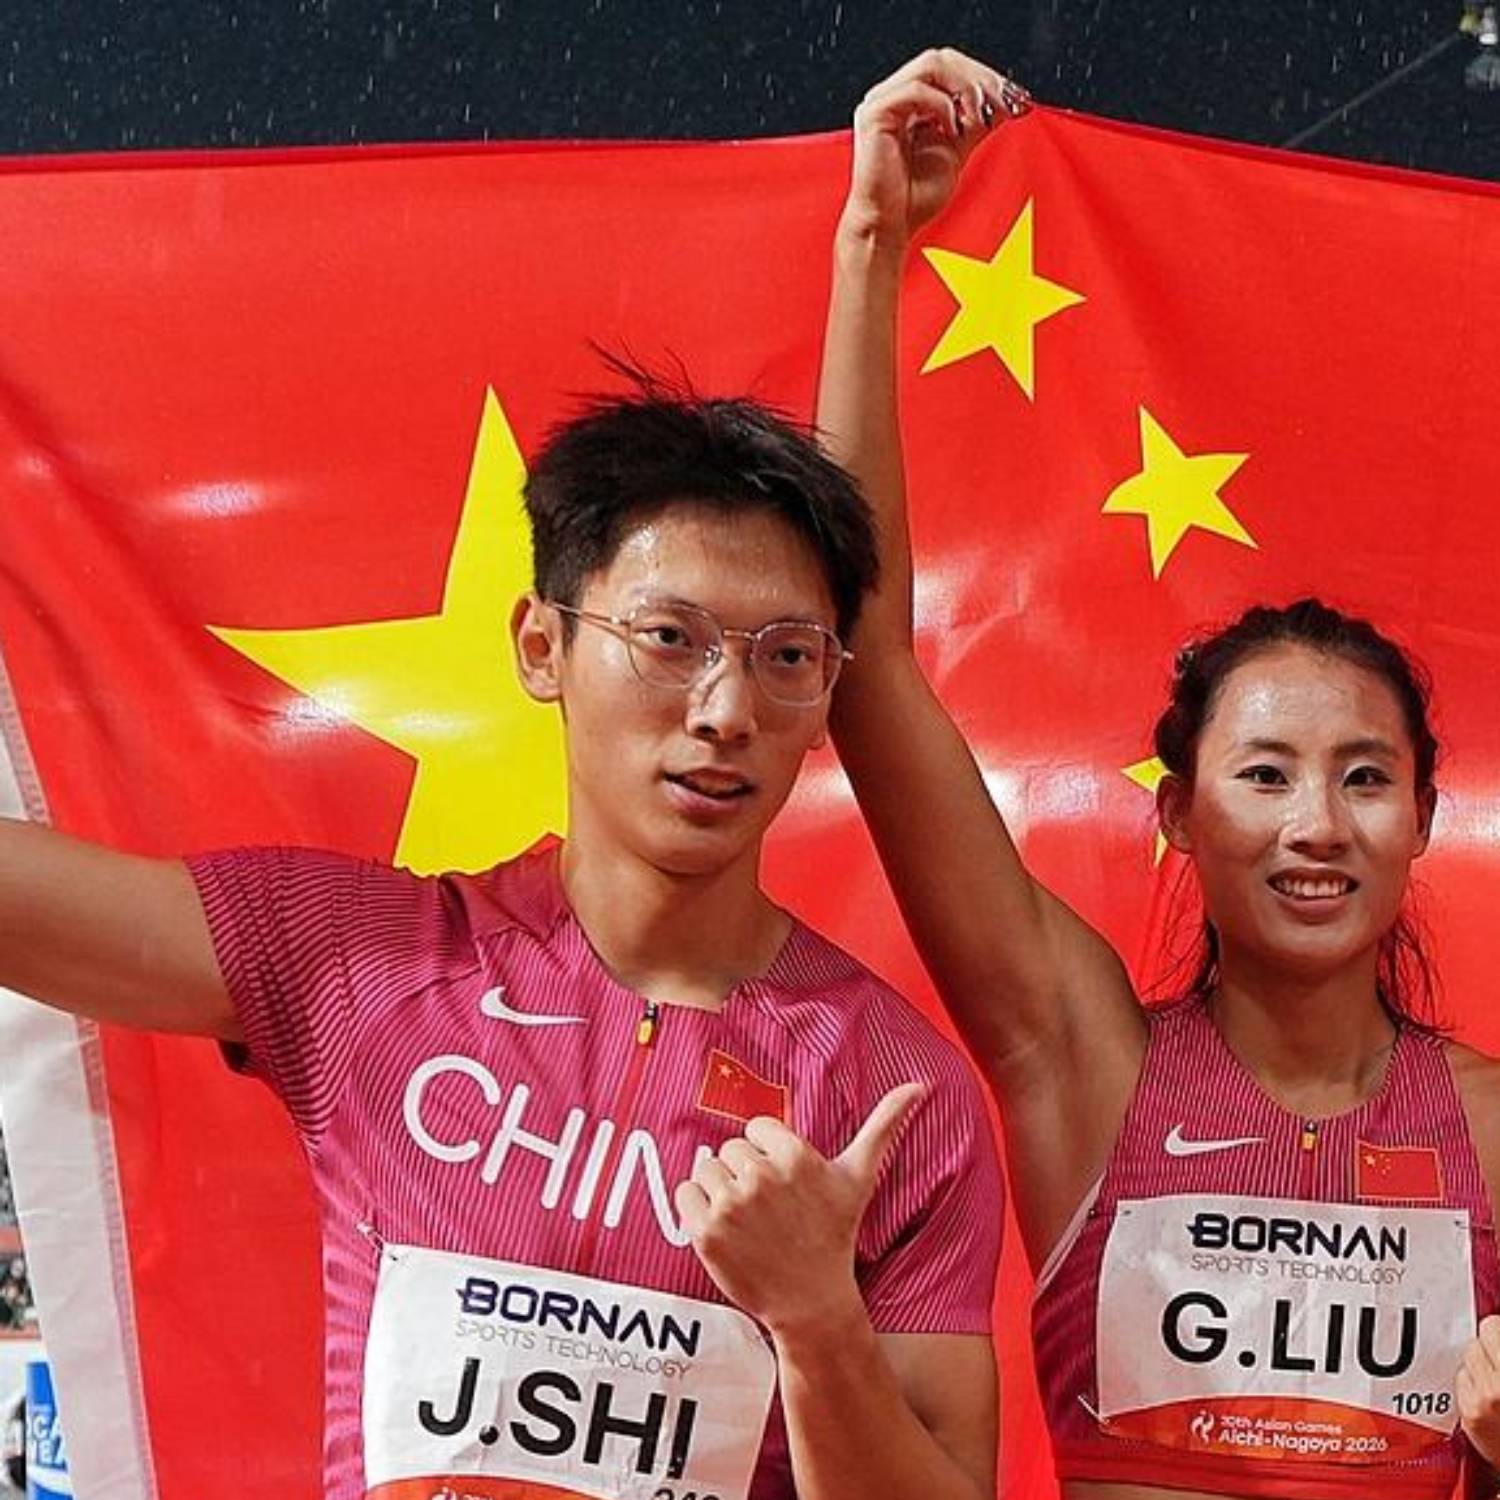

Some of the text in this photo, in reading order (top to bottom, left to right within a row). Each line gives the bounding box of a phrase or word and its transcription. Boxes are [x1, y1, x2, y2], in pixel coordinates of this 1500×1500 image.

[403, 1054, 713, 1247] CHIN
[1186, 1213, 1407, 1262] BORNAN
[1190, 1254, 1407, 1284] SPORTS TECHNOLOGY
[456, 1277, 700, 1357] BORNAN
[1161, 1291, 1418, 1378] G.LIU
[455, 1321, 694, 1380] SPORTS TECHNOLOGY
[418, 1356, 698, 1479] J.SHI
[1220, 1415, 1342, 1434] 20th Asian Games
[1392, 1393, 1451, 1415] 1018
[1218, 1429, 1388, 1453] Aichi-Nagoya 2026
